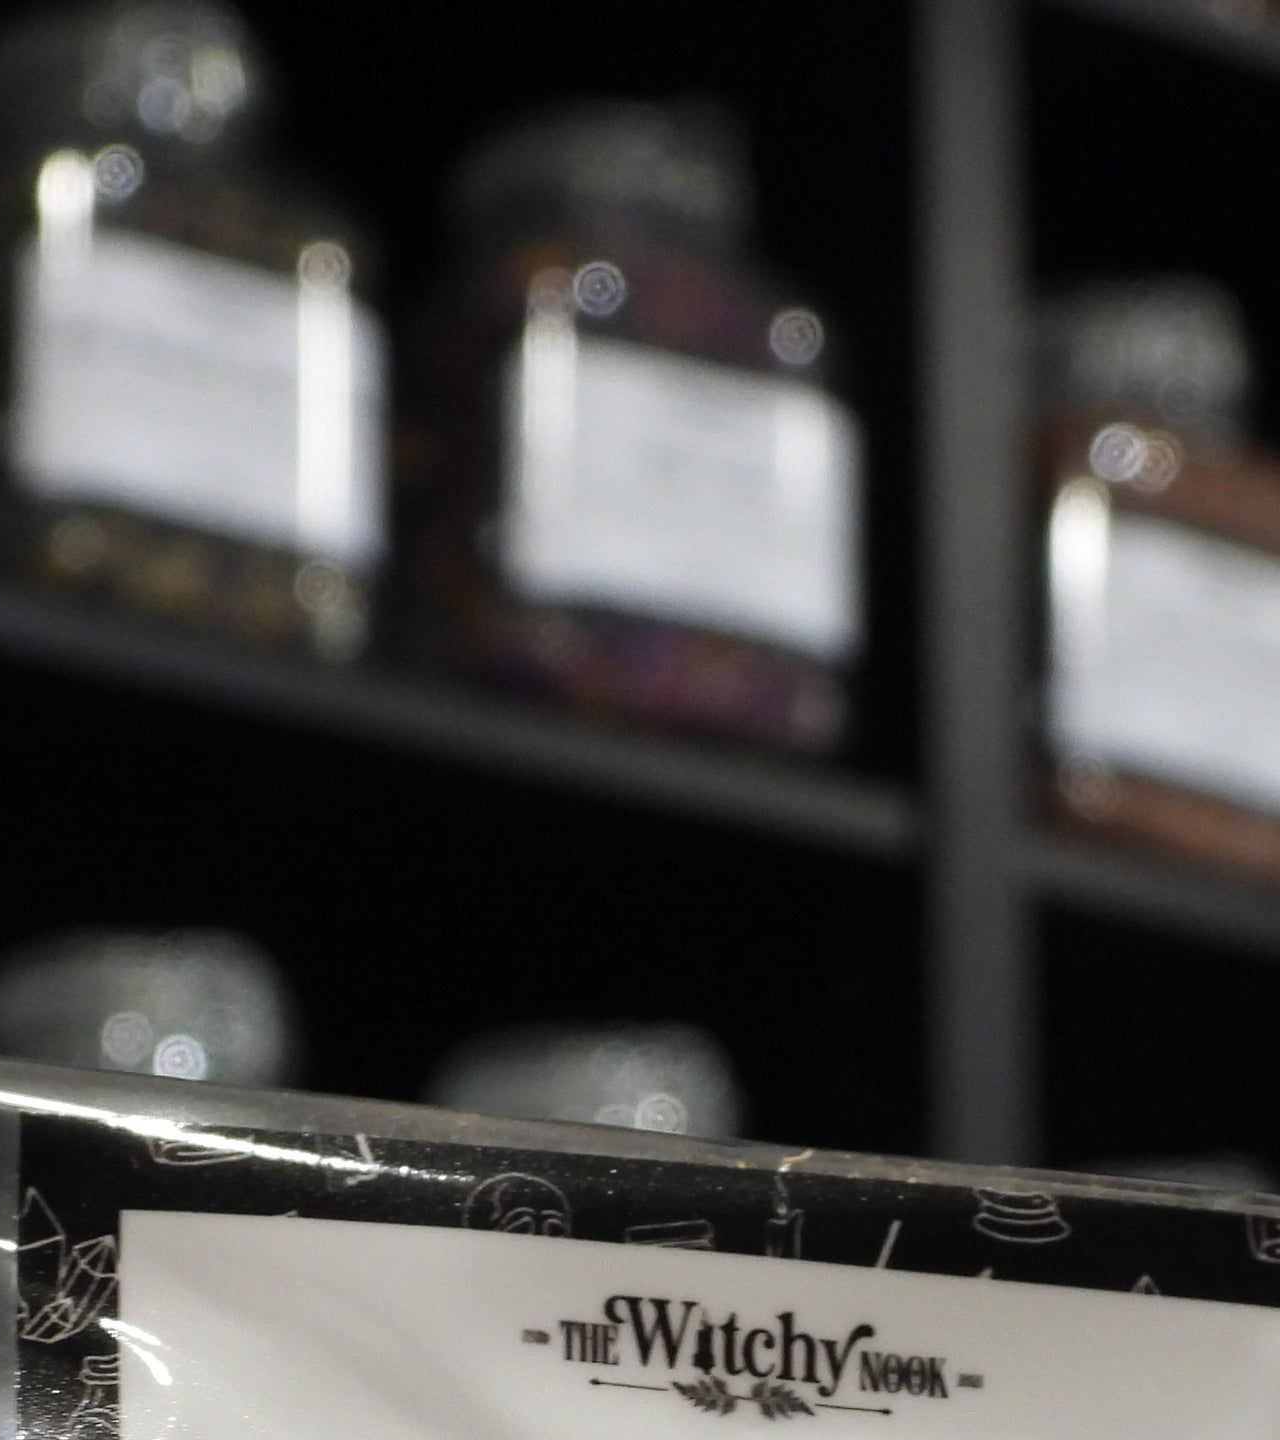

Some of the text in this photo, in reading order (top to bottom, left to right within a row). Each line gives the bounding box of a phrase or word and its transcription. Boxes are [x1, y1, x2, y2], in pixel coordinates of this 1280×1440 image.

[558, 1294, 949, 1398] THE Witchy NOOK
